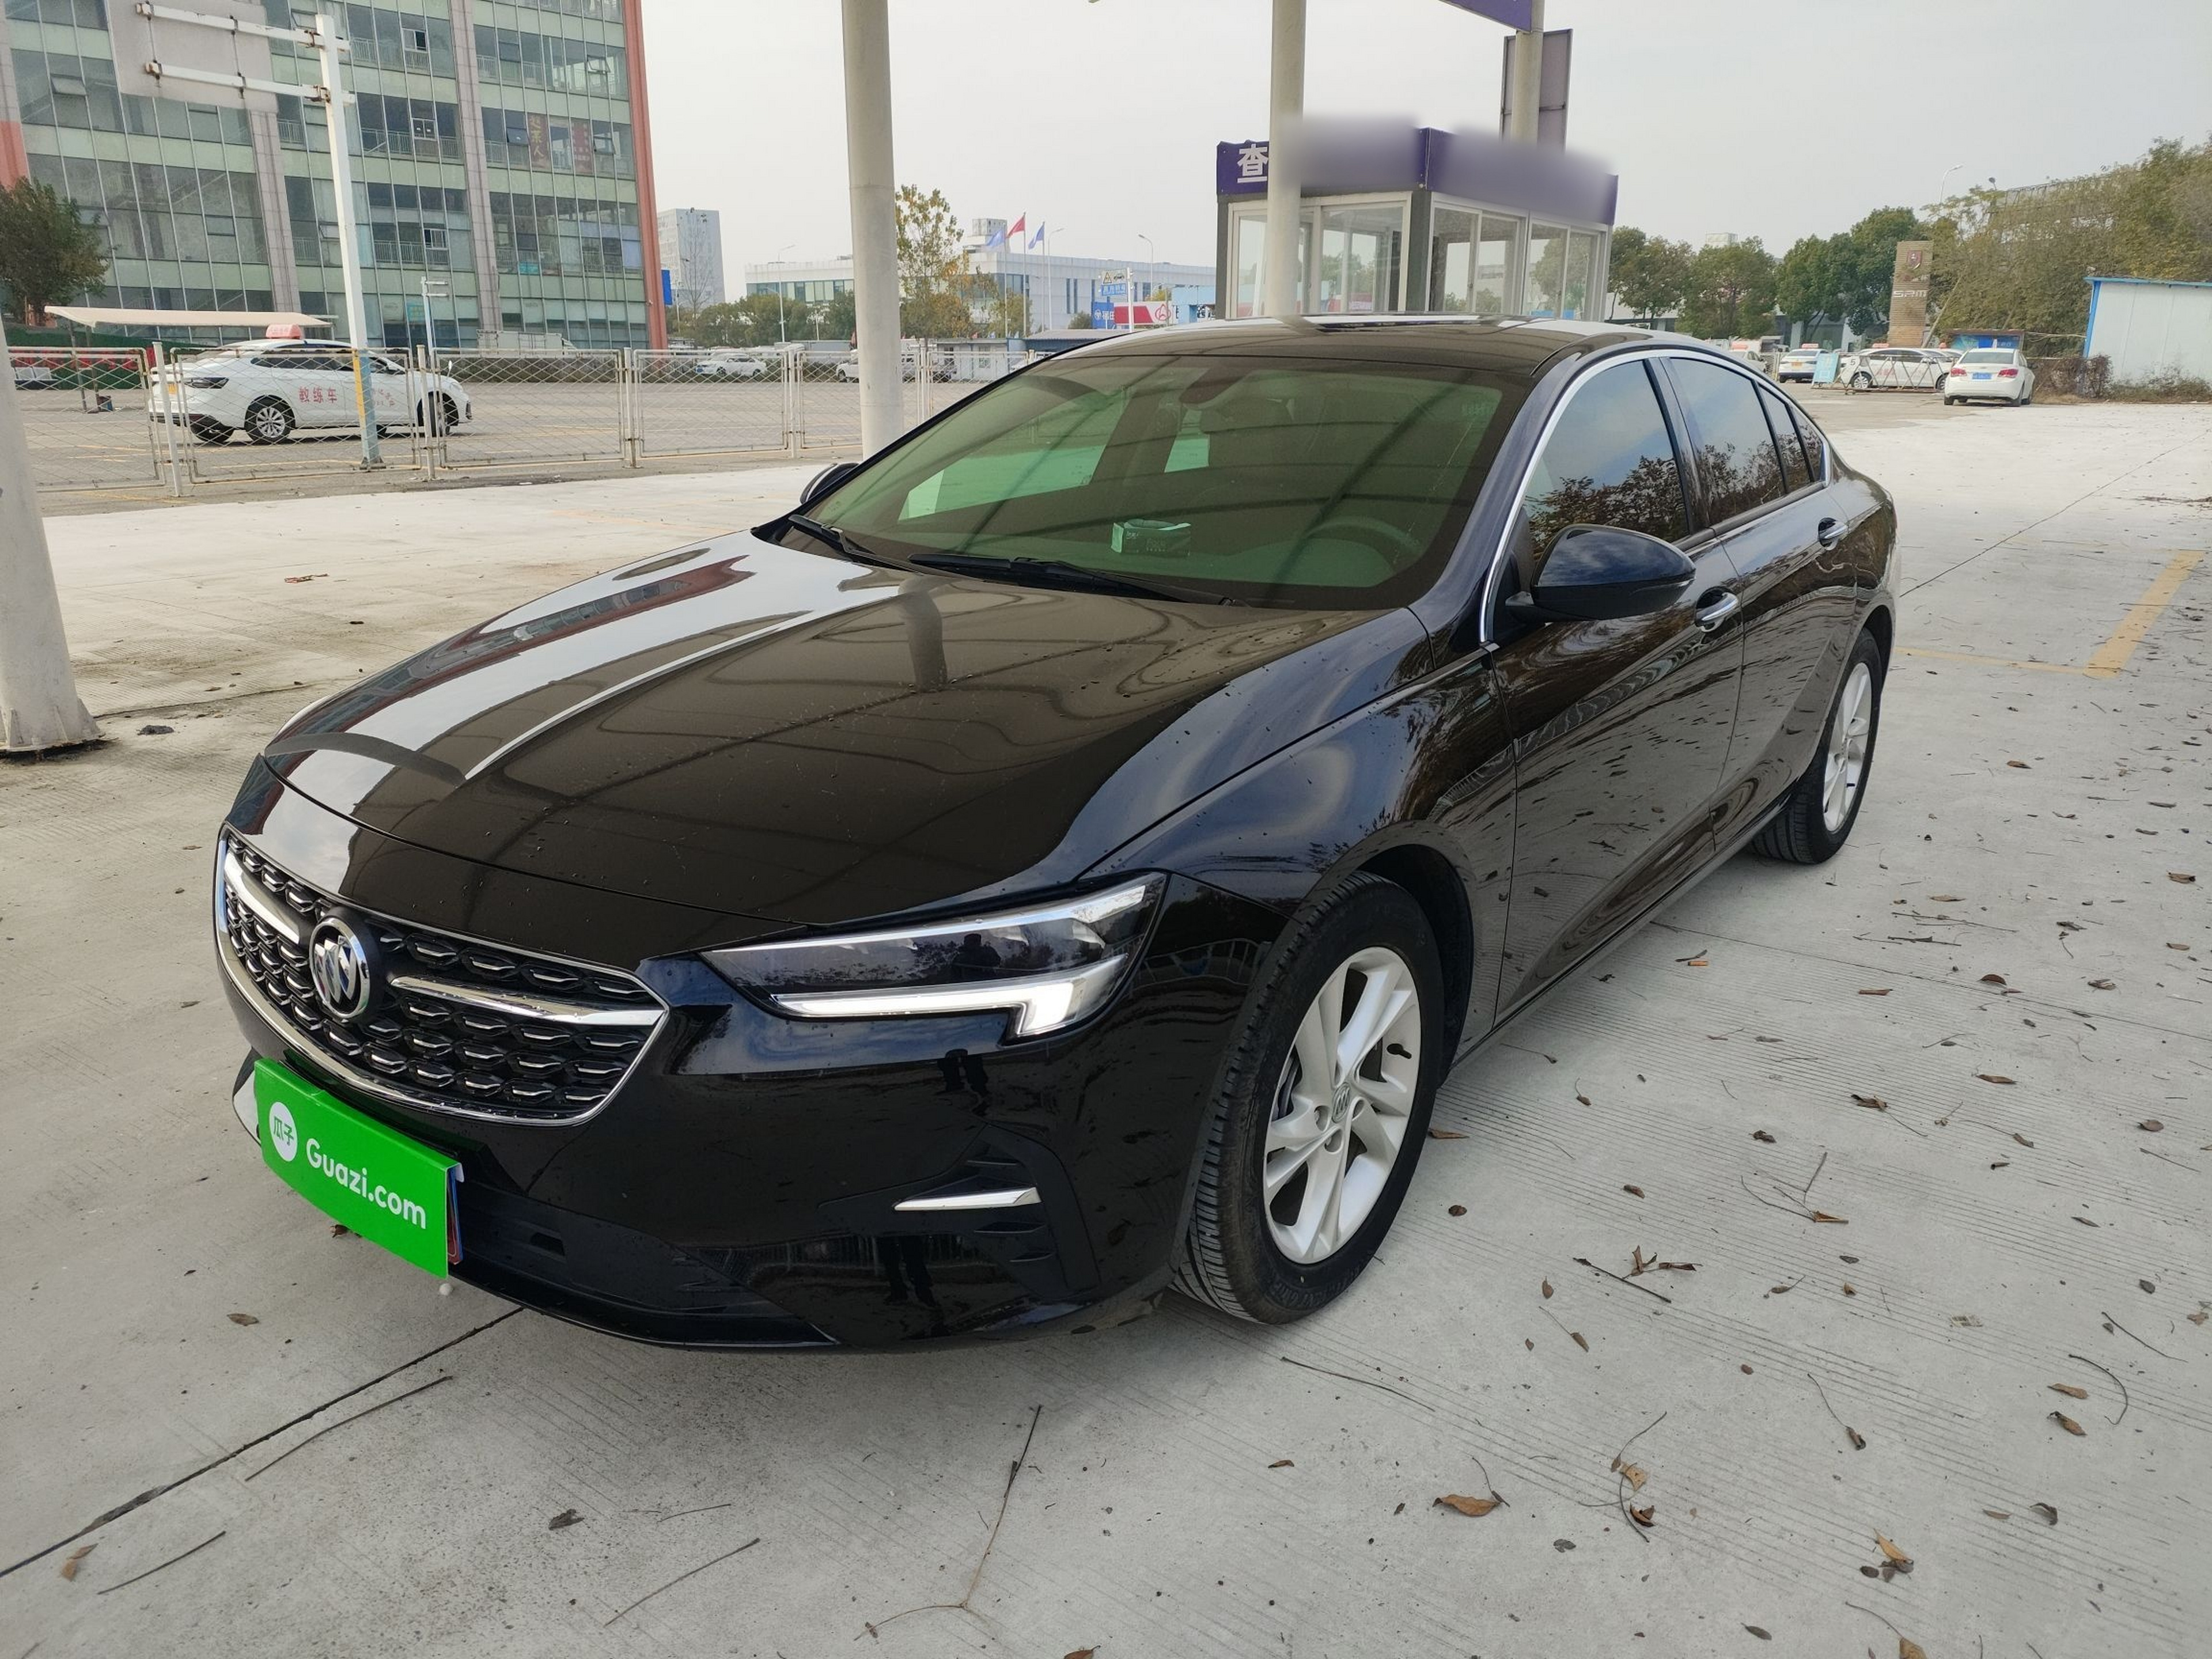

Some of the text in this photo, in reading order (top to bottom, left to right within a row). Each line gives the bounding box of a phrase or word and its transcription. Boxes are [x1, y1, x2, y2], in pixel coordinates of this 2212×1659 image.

[1237, 143, 1268, 183] 查
[299, 386, 338, 404] 教练车
[274, 1116, 294, 1146] 瓜子
[306, 1138, 426, 1229] Guazi.com
